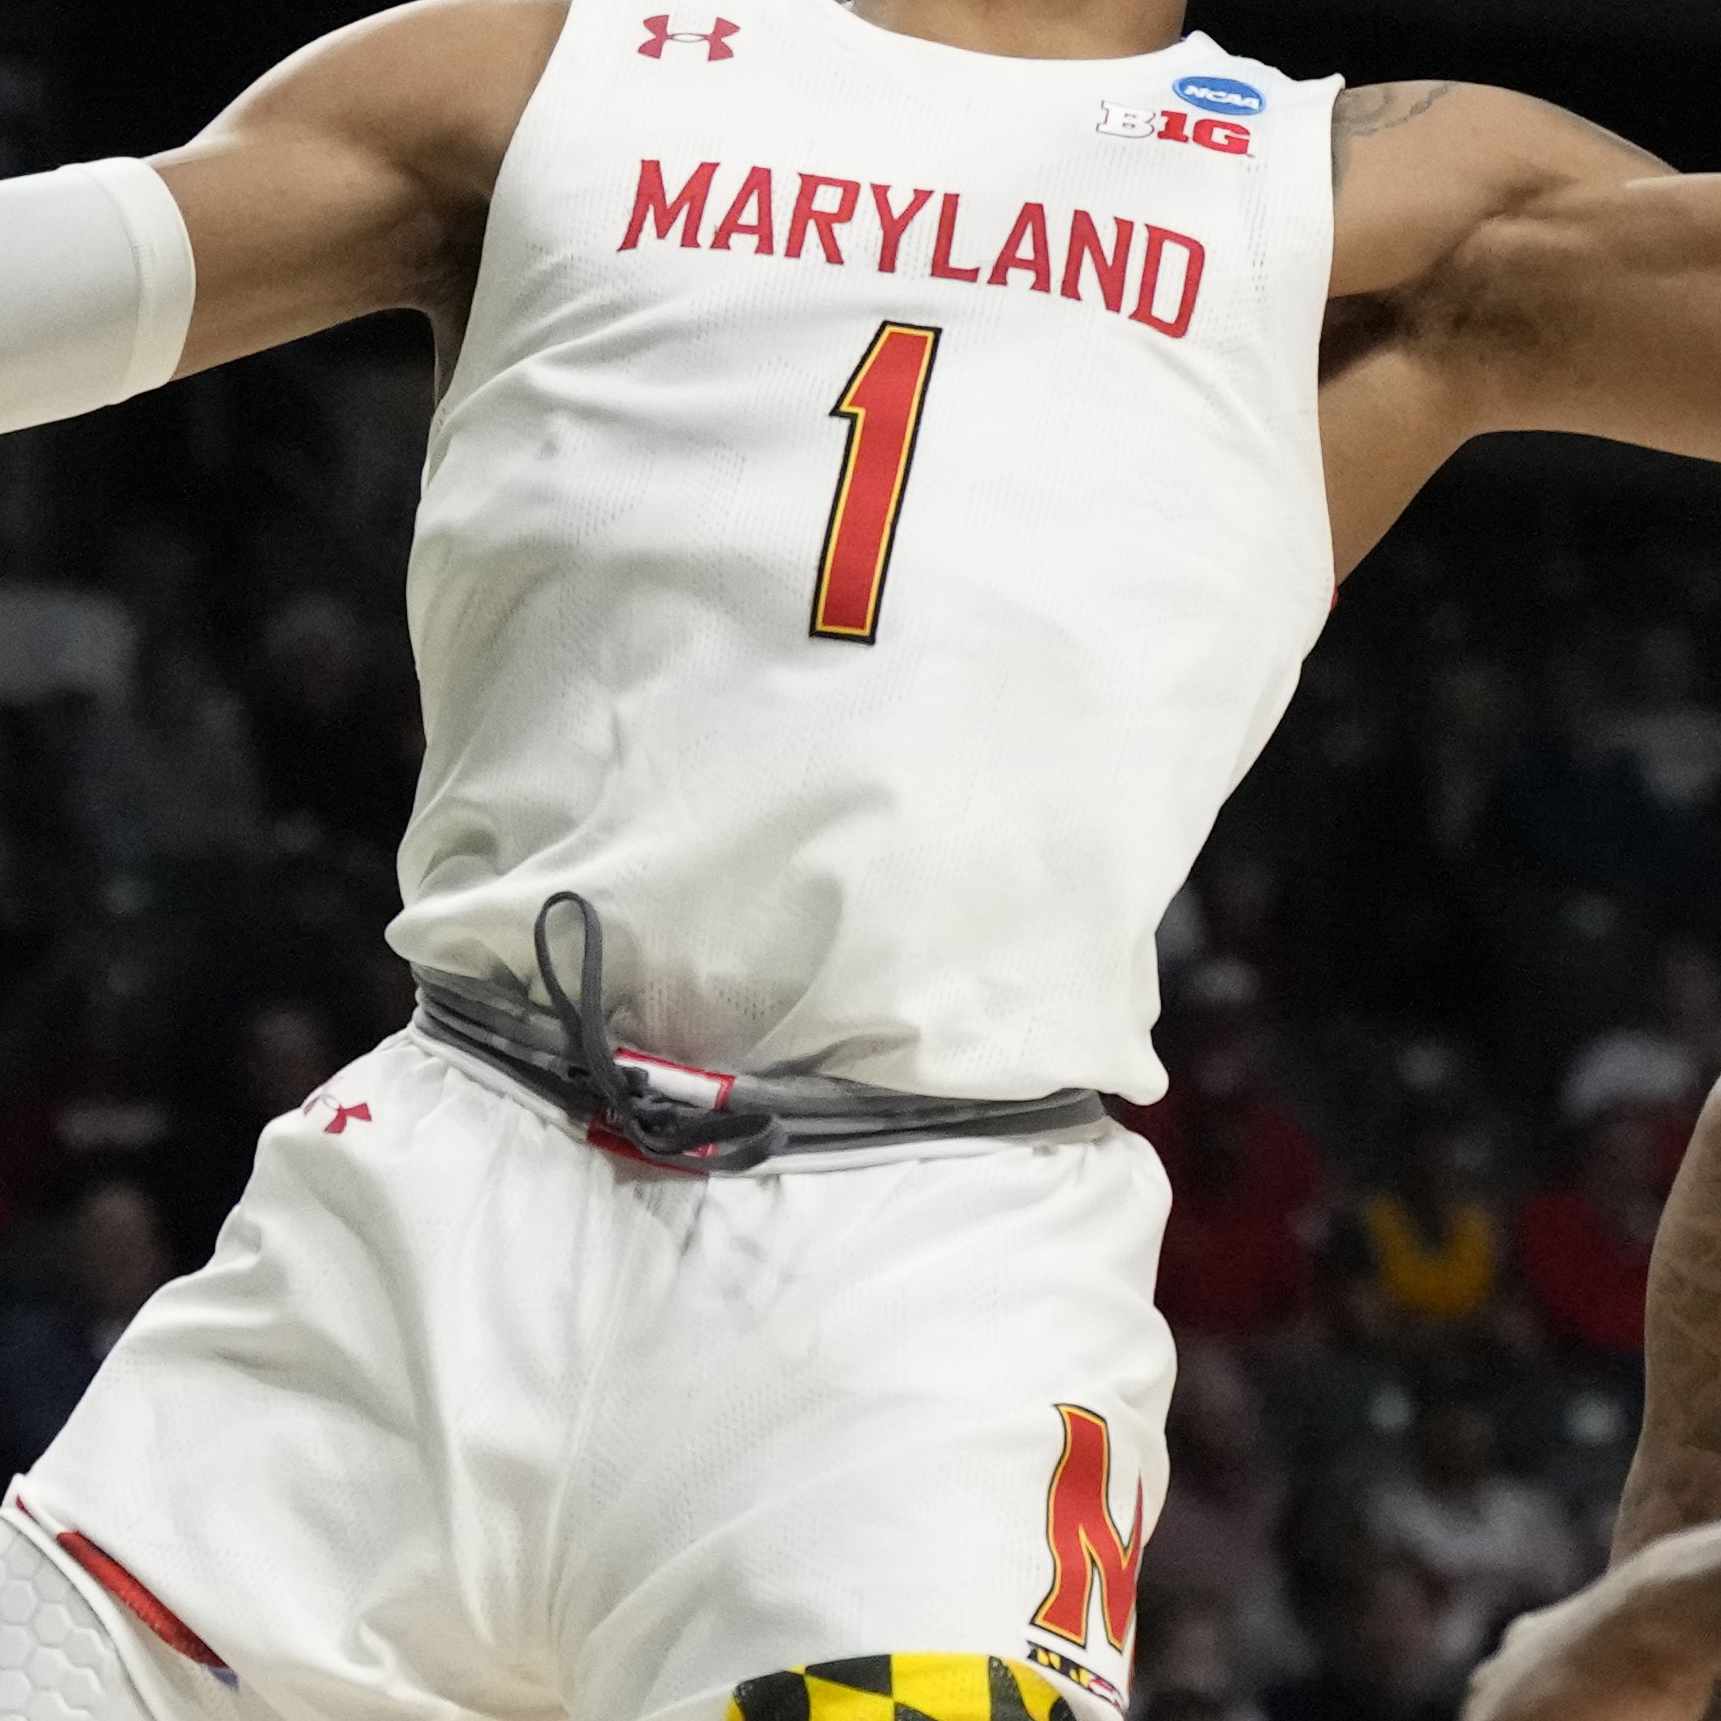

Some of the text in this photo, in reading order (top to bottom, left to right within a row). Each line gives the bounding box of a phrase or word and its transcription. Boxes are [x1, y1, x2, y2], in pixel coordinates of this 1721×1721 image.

[1181, 83, 1261, 112] NCAA
[617, 158, 1207, 340] MARYLAND
[808, 319, 943, 645] 1
